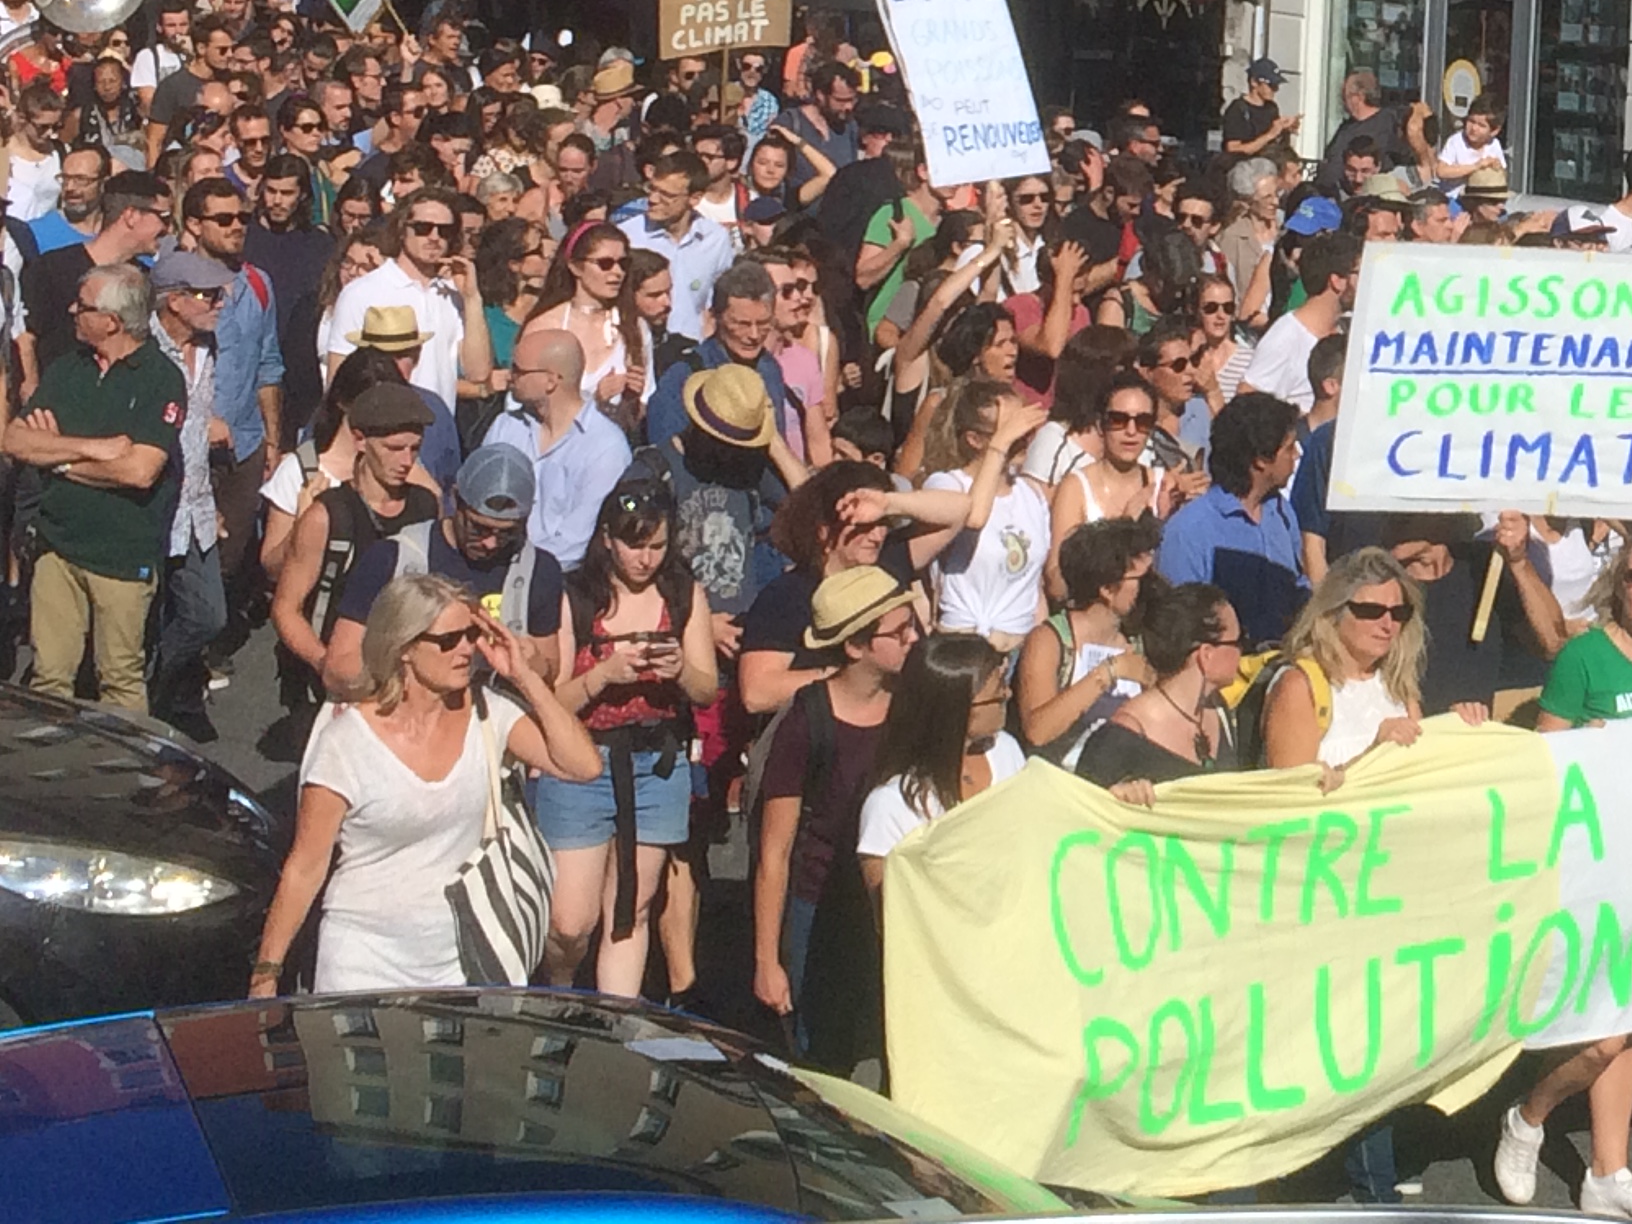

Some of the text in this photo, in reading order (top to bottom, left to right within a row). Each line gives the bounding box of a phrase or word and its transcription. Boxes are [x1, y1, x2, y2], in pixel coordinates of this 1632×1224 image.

[680, 0, 729, 26] PAS
[671, 19, 770, 50] CLIMAT
[953, 98, 991, 116] PEUT
[1387, 379, 1537, 417] POUR
[1050, 761, 1604, 986] CONTRE LA
